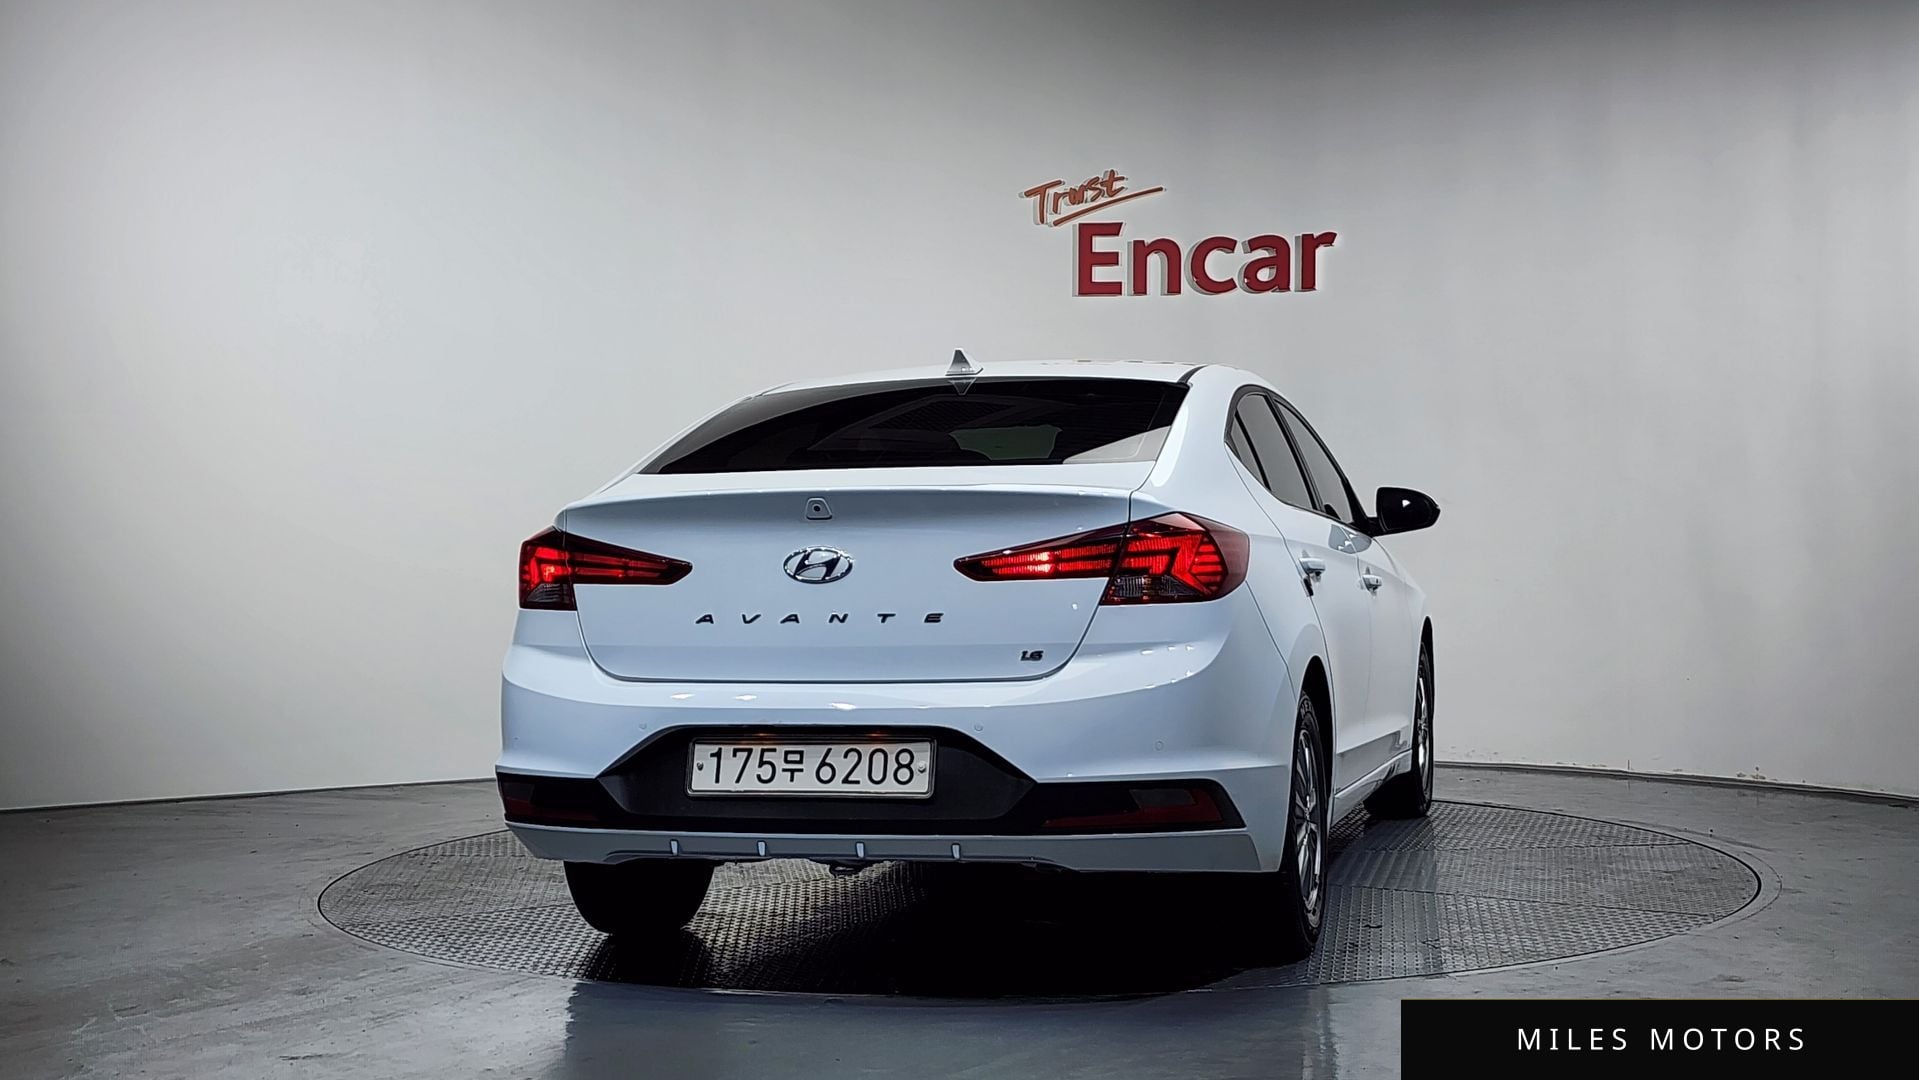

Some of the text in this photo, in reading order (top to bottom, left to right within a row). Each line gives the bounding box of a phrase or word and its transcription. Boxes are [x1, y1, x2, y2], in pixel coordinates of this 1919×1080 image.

[1020, 168, 1128, 225] Trust
[1074, 222, 1338, 296] Encar
[696, 612, 944, 624] AVANTE
[709, 747, 915, 786] 175무 6208
